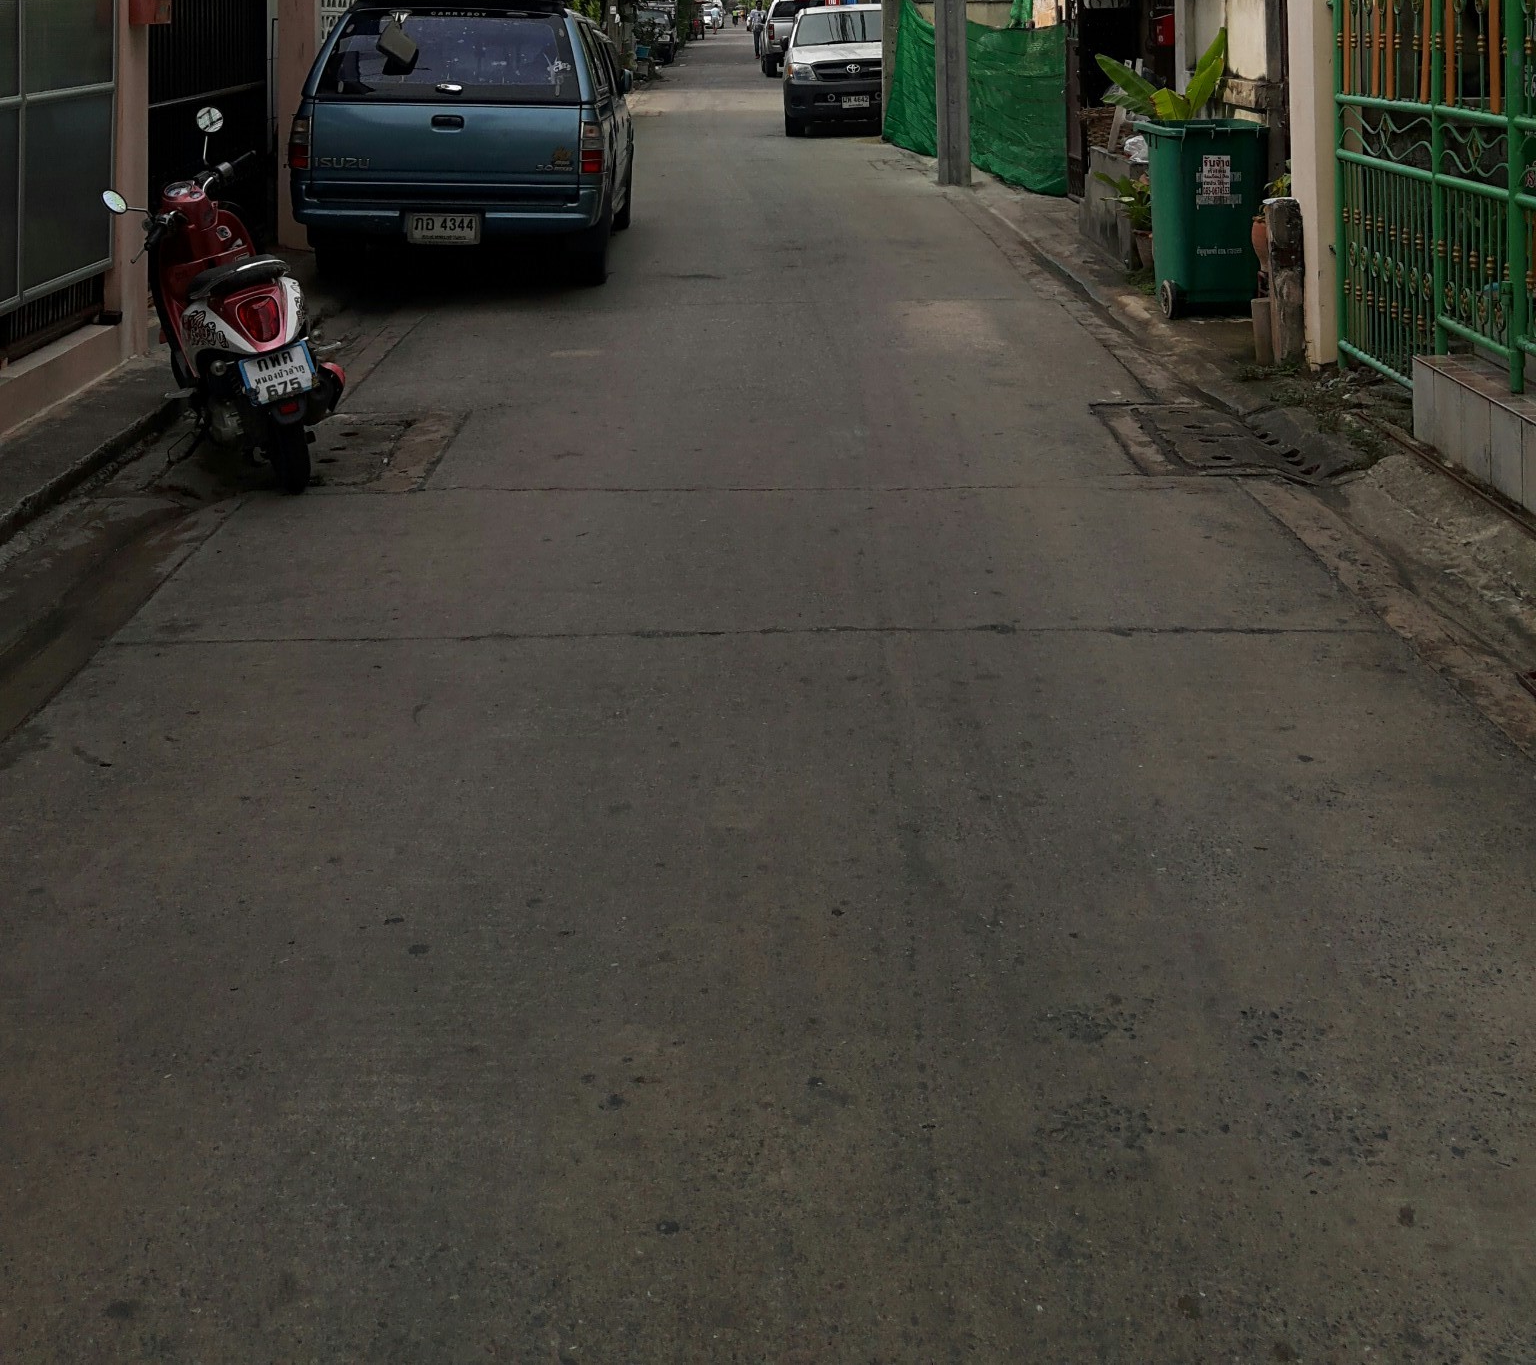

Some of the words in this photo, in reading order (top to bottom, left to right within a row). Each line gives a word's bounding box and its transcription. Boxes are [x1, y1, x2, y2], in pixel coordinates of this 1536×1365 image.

[314, 157, 370, 169] ISUZU
[440, 217, 474, 232] 4344
[265, 377, 303, 402] 675
